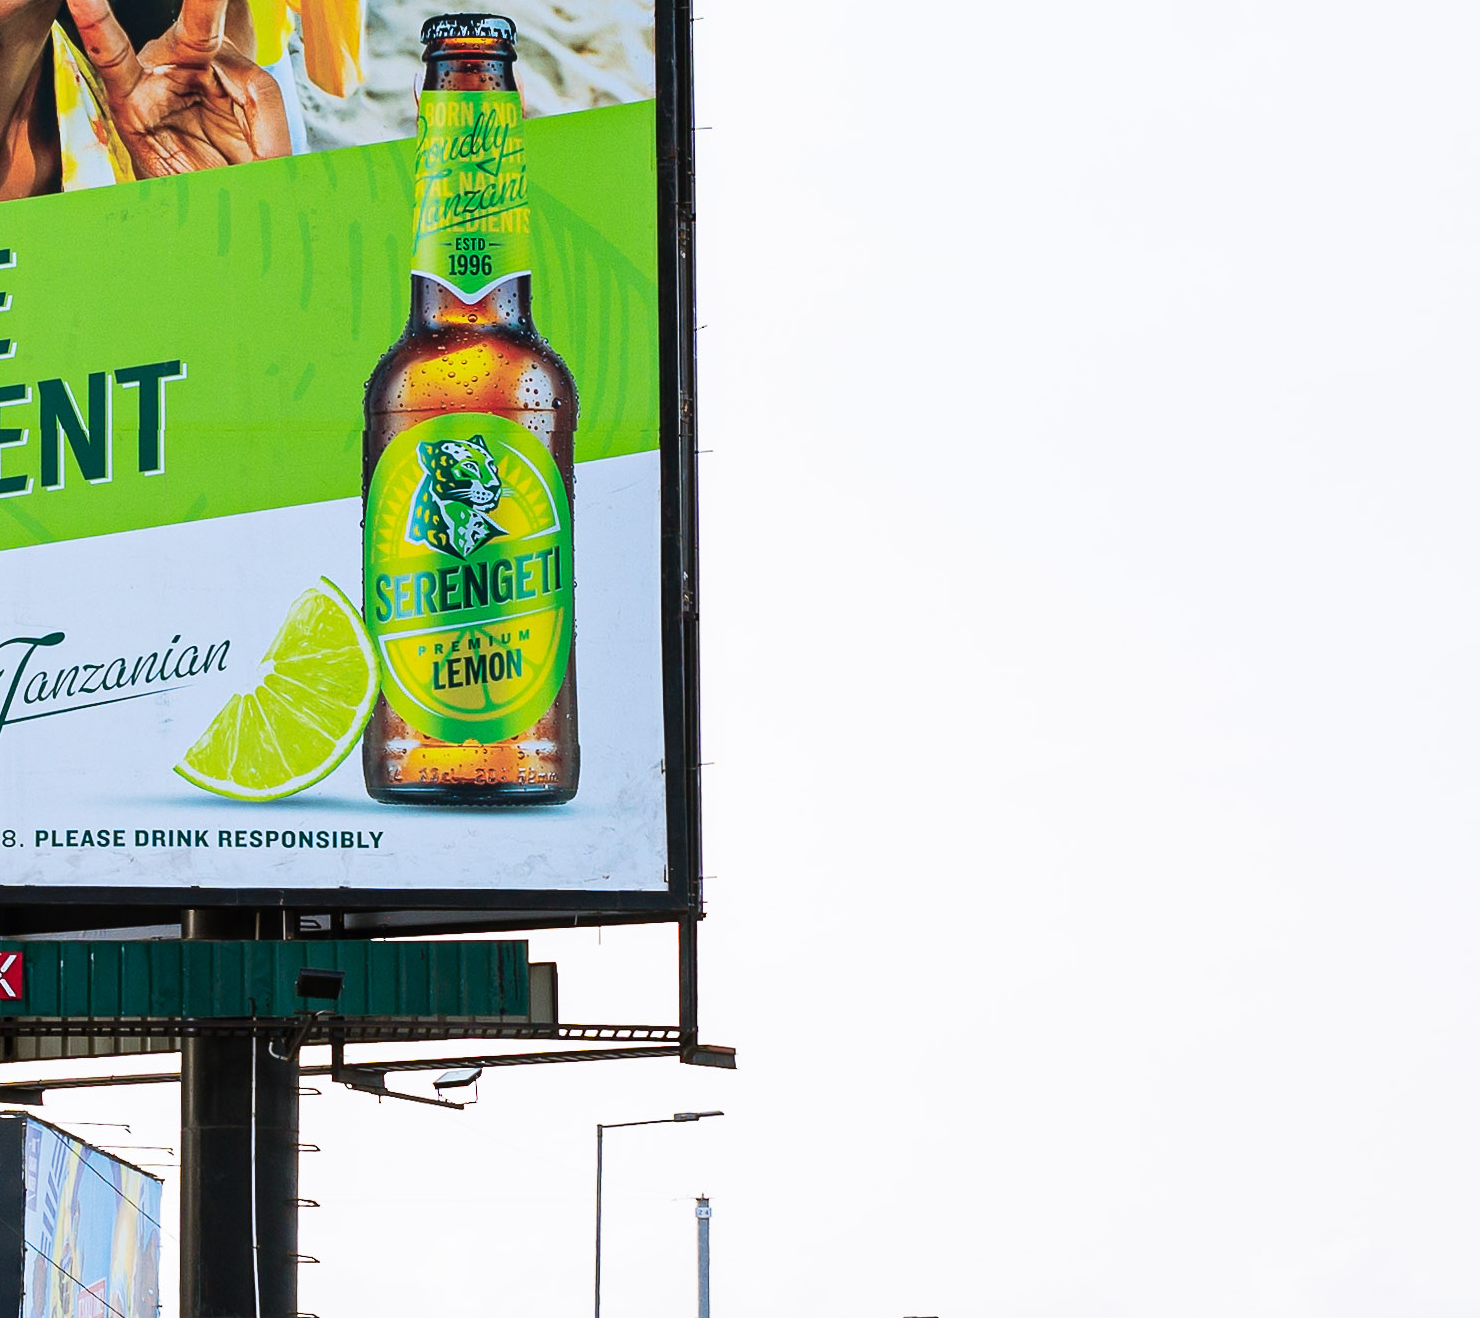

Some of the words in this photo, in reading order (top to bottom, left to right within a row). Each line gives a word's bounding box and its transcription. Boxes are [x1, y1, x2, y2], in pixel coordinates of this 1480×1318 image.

[455, 237, 487, 251] ESTD
[448, 254, 493, 276] 1996
[375, 546, 564, 623] SERENGETI
[417, 628, 531, 658] PREMIUM
[431, 647, 523, 691] LEMON
[35, 829, 126, 848] PLEASE
[134, 829, 209, 848] DRINK
[218, 829, 384, 849] RESPONSIBLY
